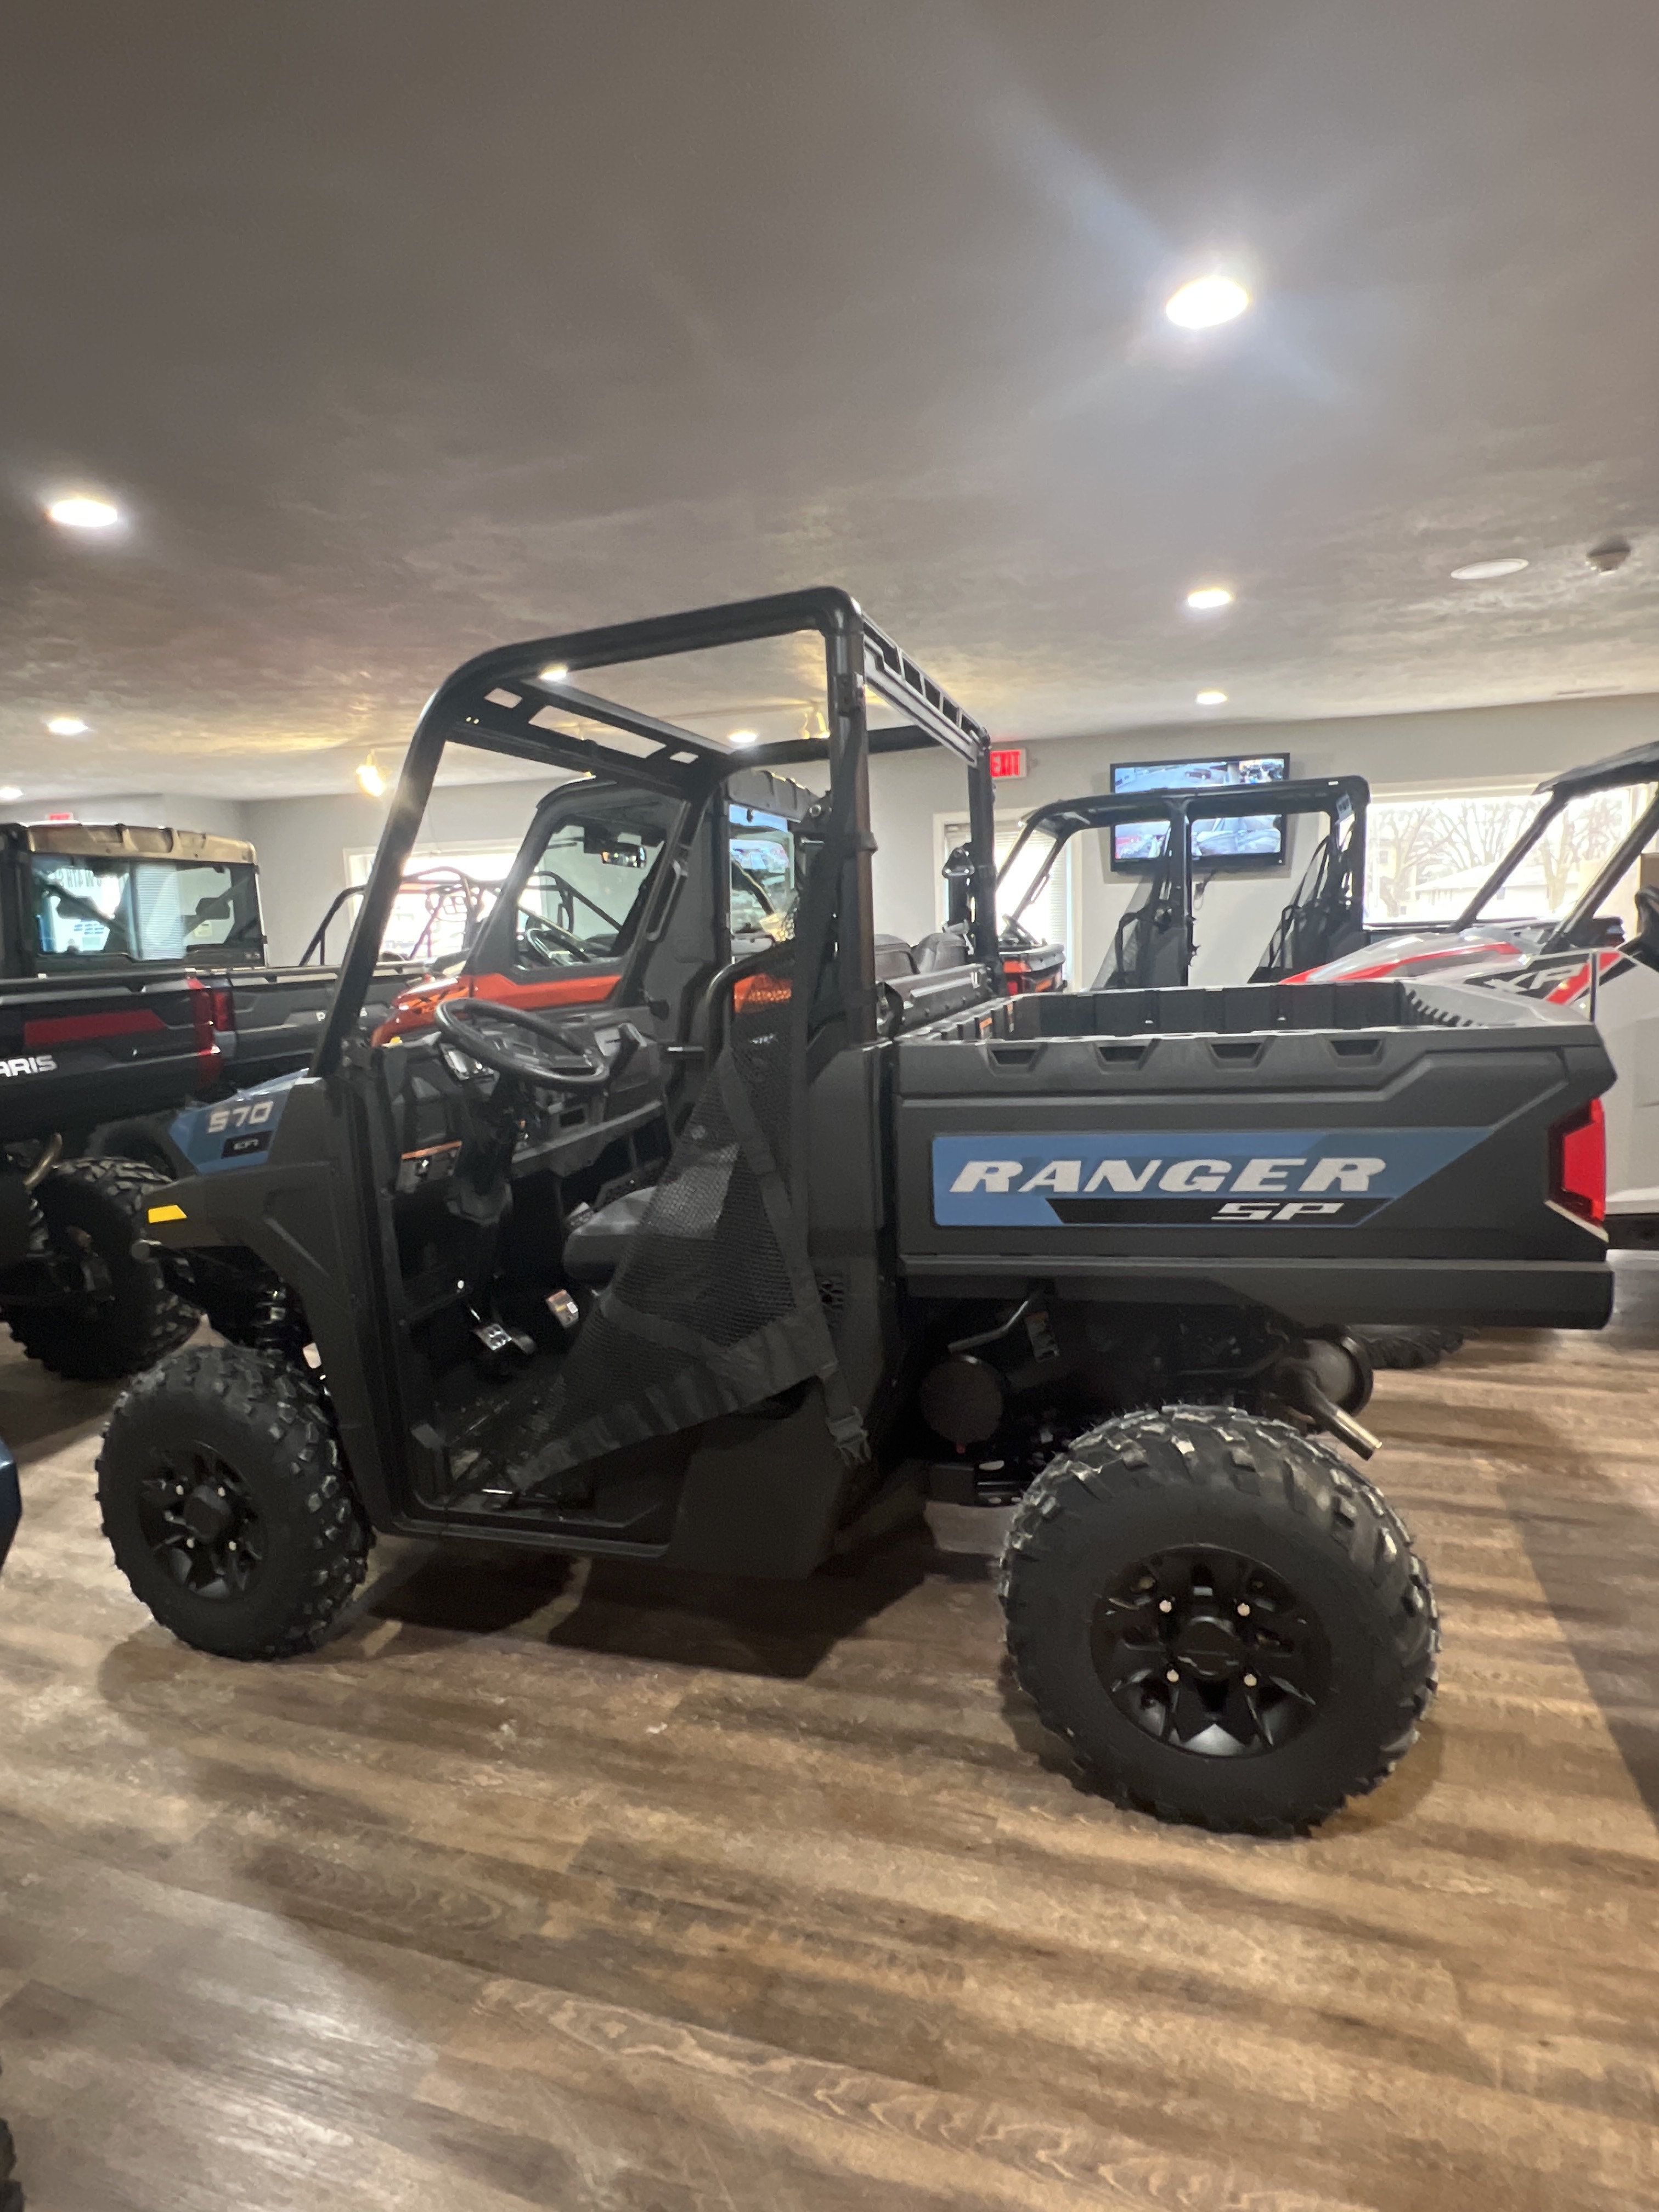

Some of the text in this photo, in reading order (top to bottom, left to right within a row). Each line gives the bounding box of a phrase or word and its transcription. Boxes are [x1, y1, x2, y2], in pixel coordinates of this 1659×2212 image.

[990, 750, 1020, 777] EXIT
[207, 1101, 273, 1133] 570
[949, 1157, 1386, 1193] RANGER
[1210, 1202, 1344, 1221] SP
